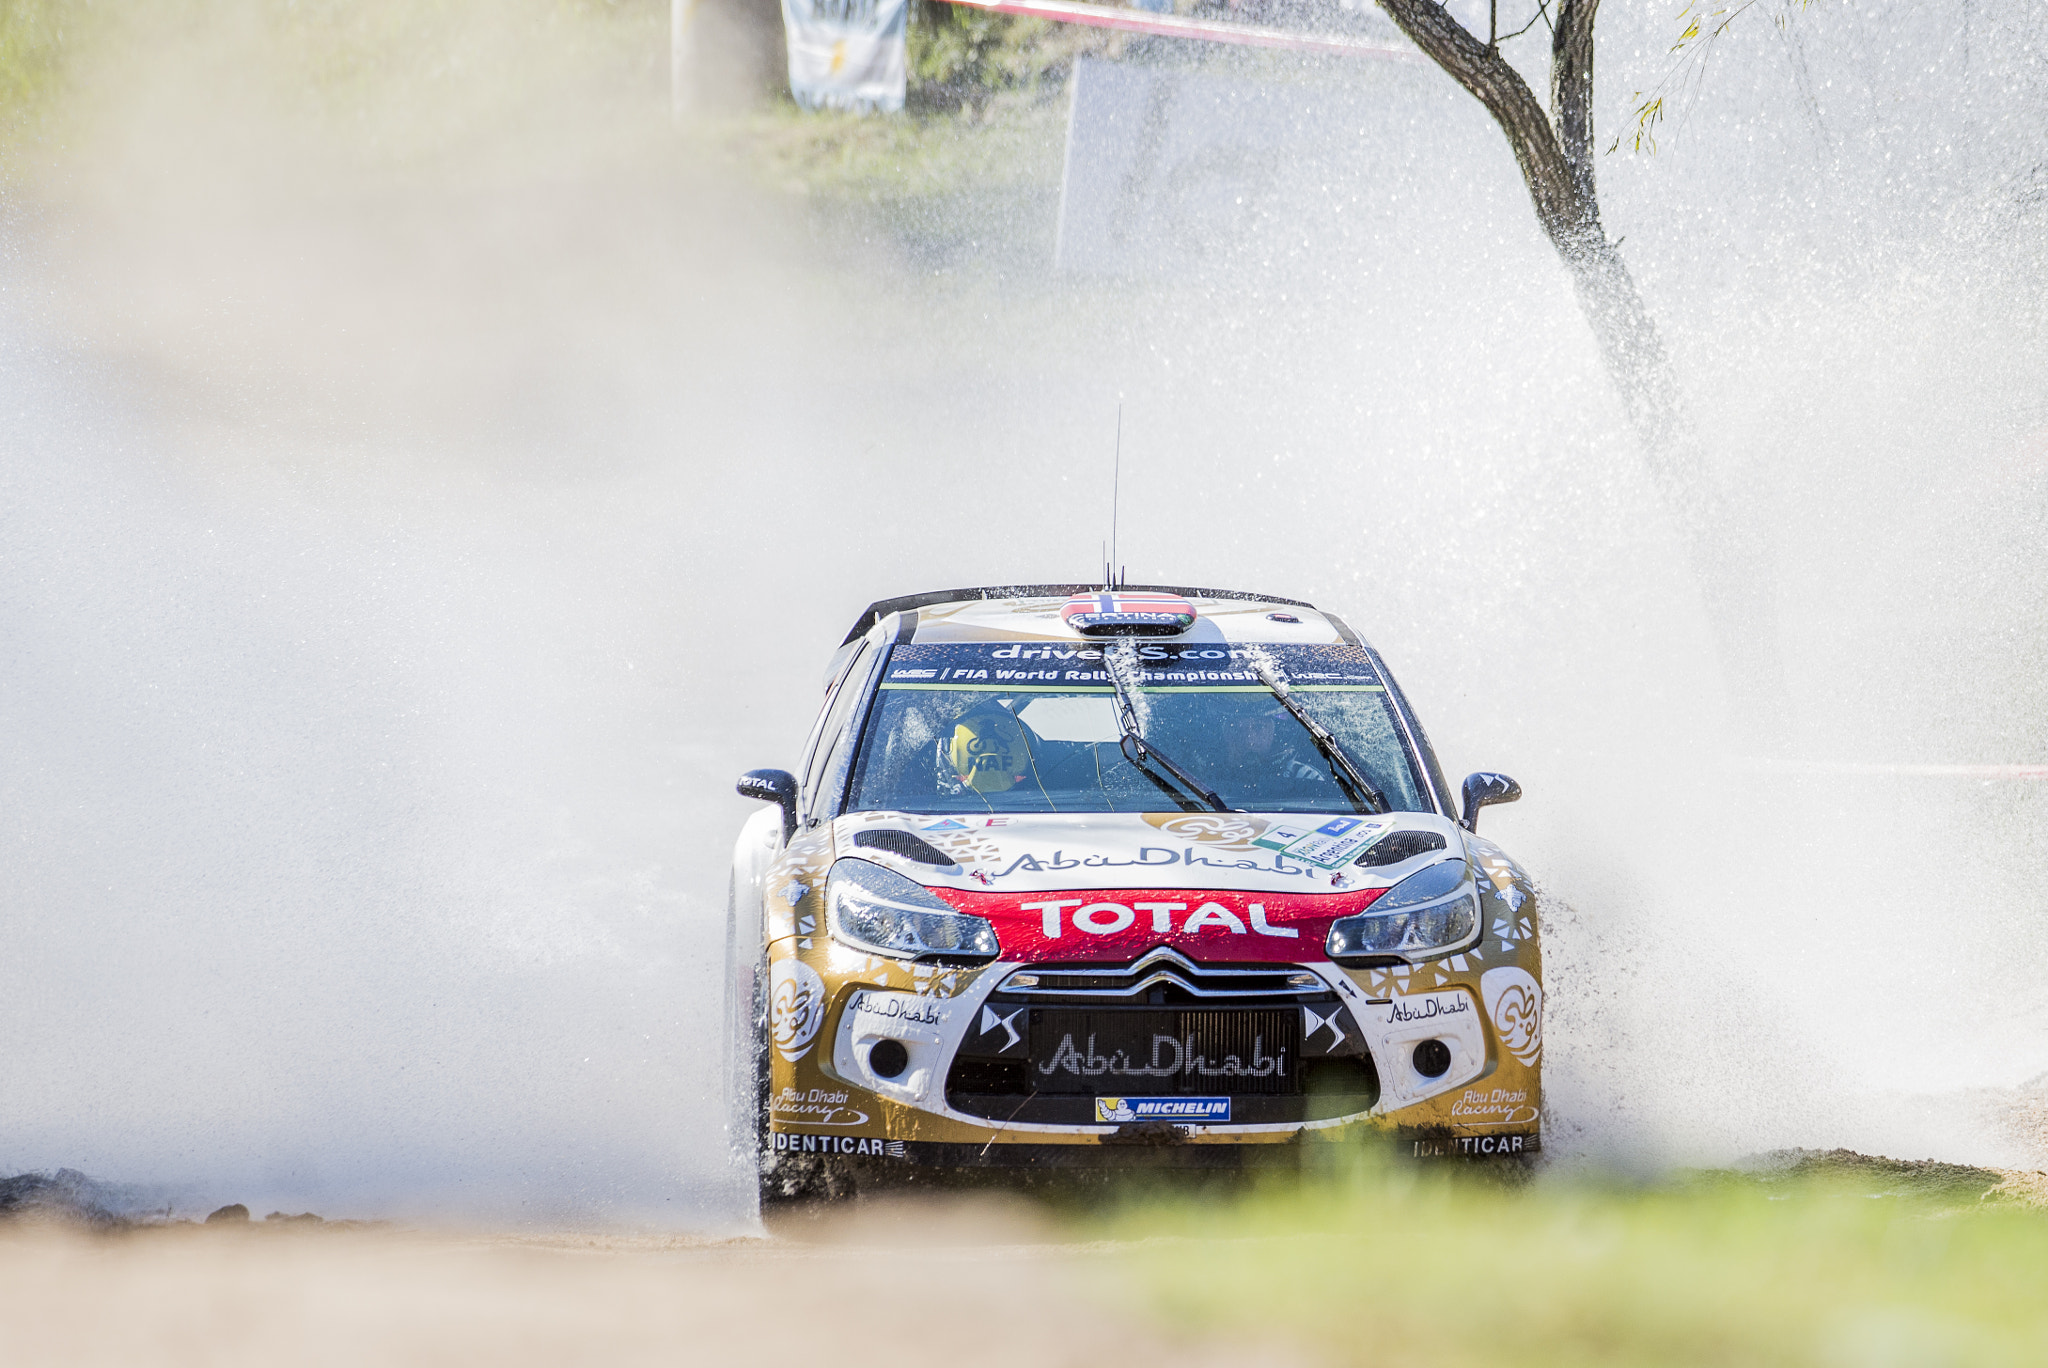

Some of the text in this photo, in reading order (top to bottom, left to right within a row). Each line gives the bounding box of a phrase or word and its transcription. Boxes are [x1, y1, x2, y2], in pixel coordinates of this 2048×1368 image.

[952, 669, 988, 679] FIA
[996, 670, 1058, 680] World
[967, 755, 1014, 772] NAF
[739, 776, 776, 791] TOTAL
[1020, 899, 1299, 939] TOTAL
[782, 1087, 849, 1104] Abu Dhabi
[1463, 1089, 1527, 1104] Abu Dhabi
[1136, 1102, 1228, 1114] MICHELIN
[1451, 1100, 1524, 1122] Racing
[771, 1132, 884, 1156] IDENTICAR
[1413, 1136, 1523, 1158] IDTICAR
